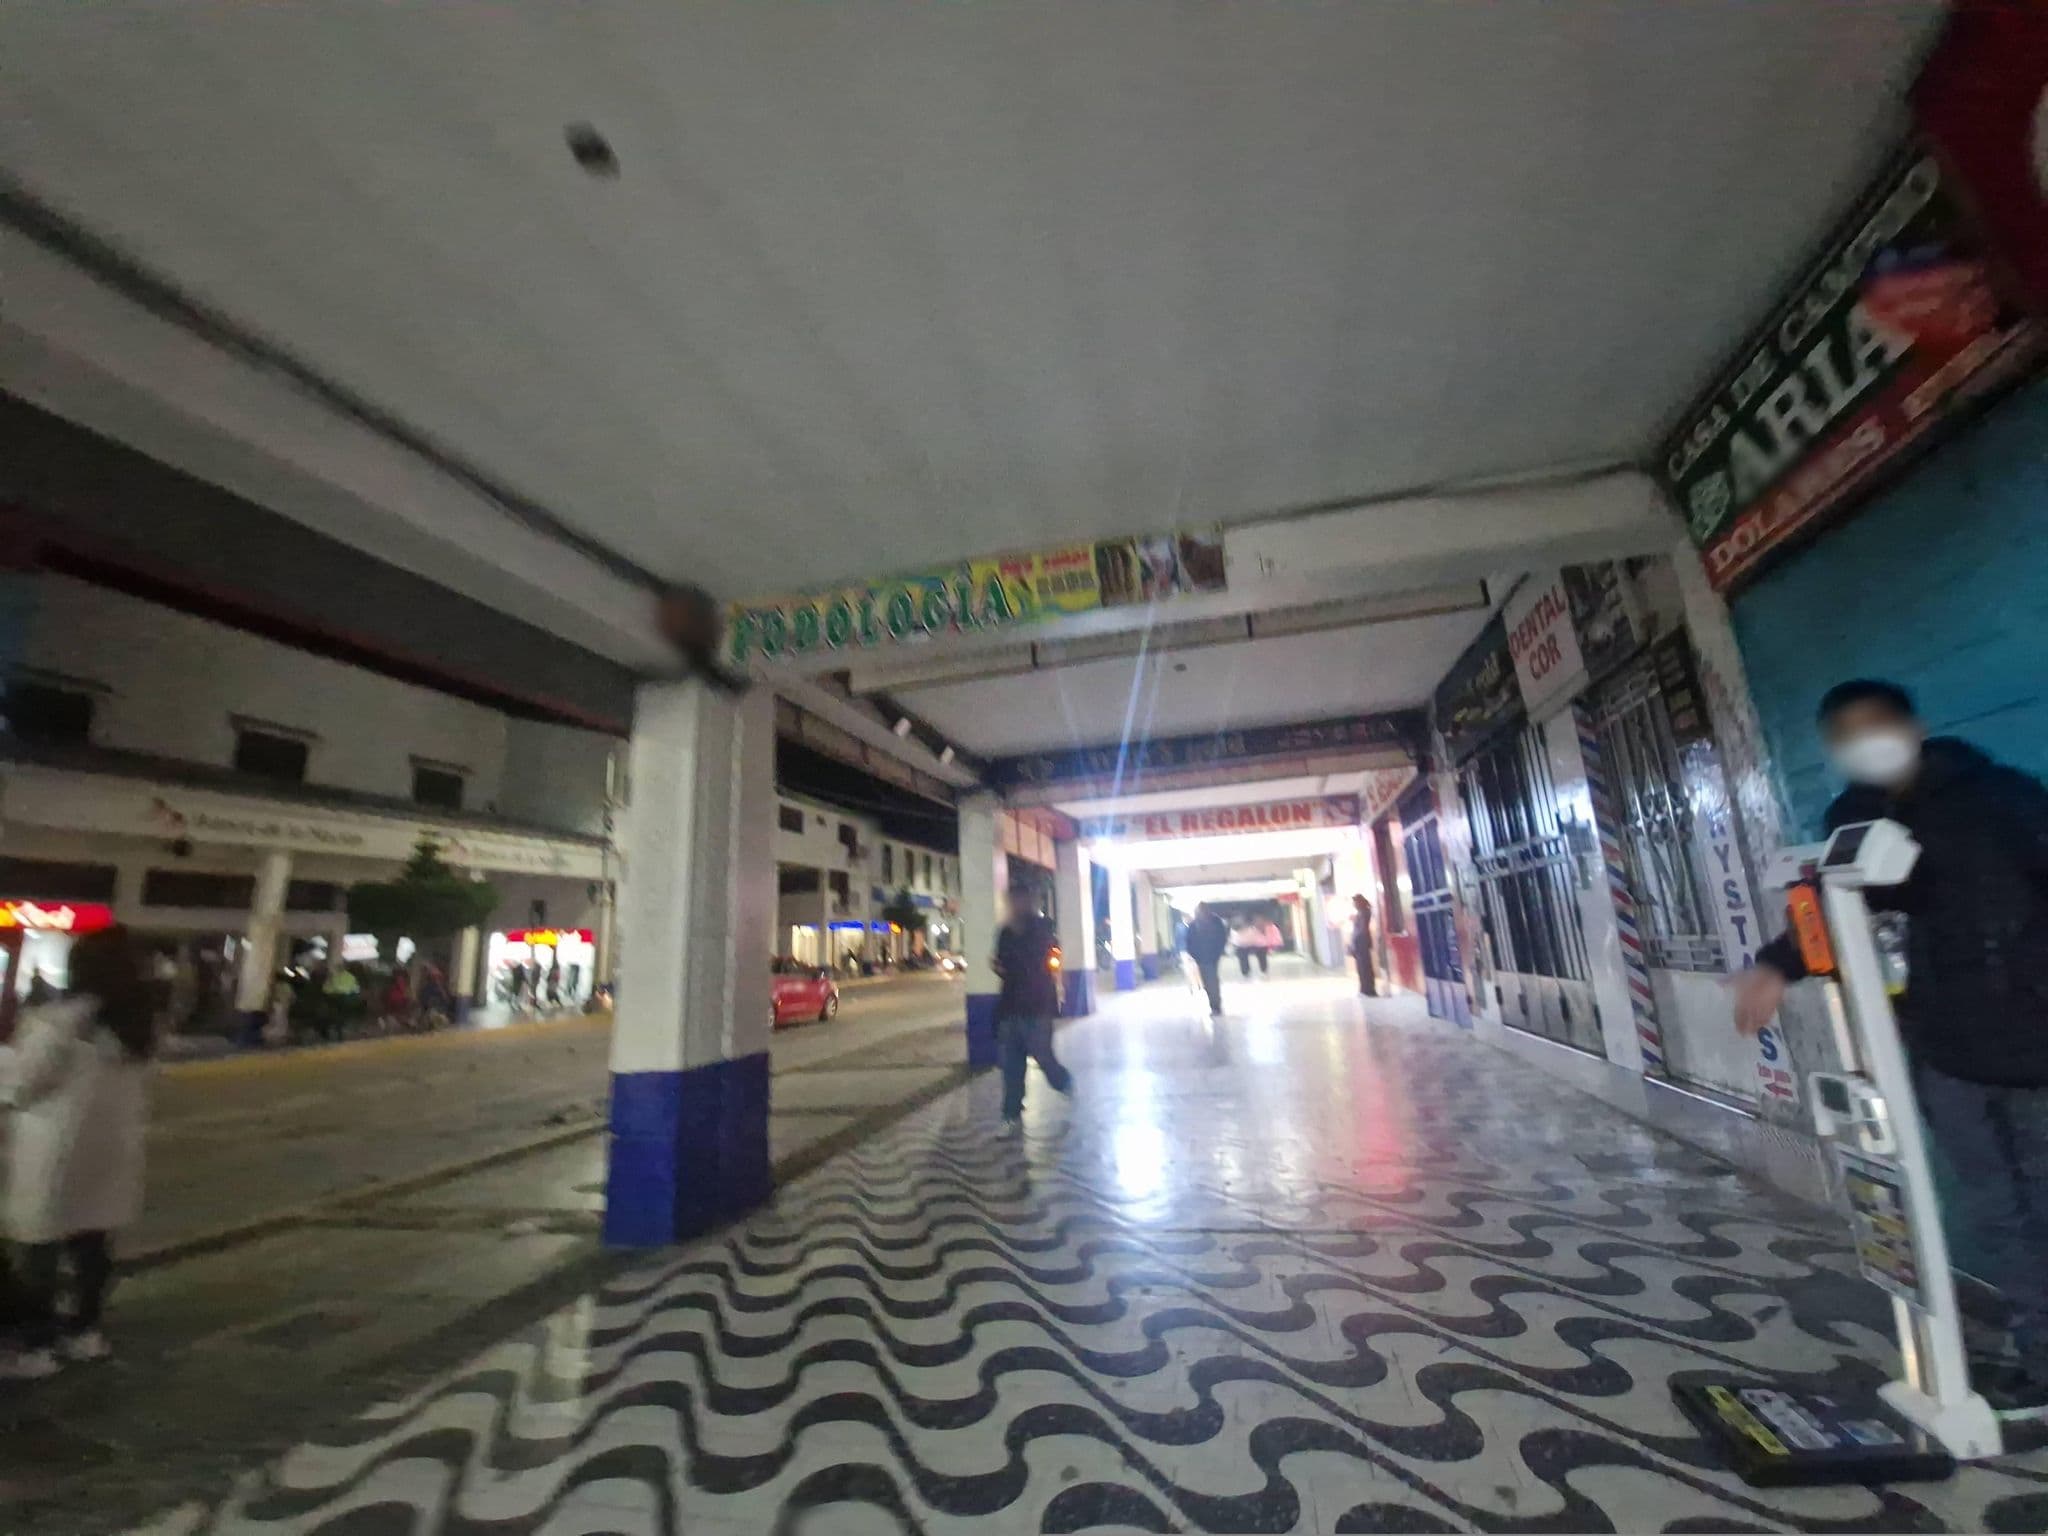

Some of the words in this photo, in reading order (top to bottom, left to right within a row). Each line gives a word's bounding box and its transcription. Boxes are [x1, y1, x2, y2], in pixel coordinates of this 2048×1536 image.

[1779, 156, 1941, 354] CAMO
[1508, 585, 1568, 659] DENTAL
[1528, 635, 1562, 681] COR
